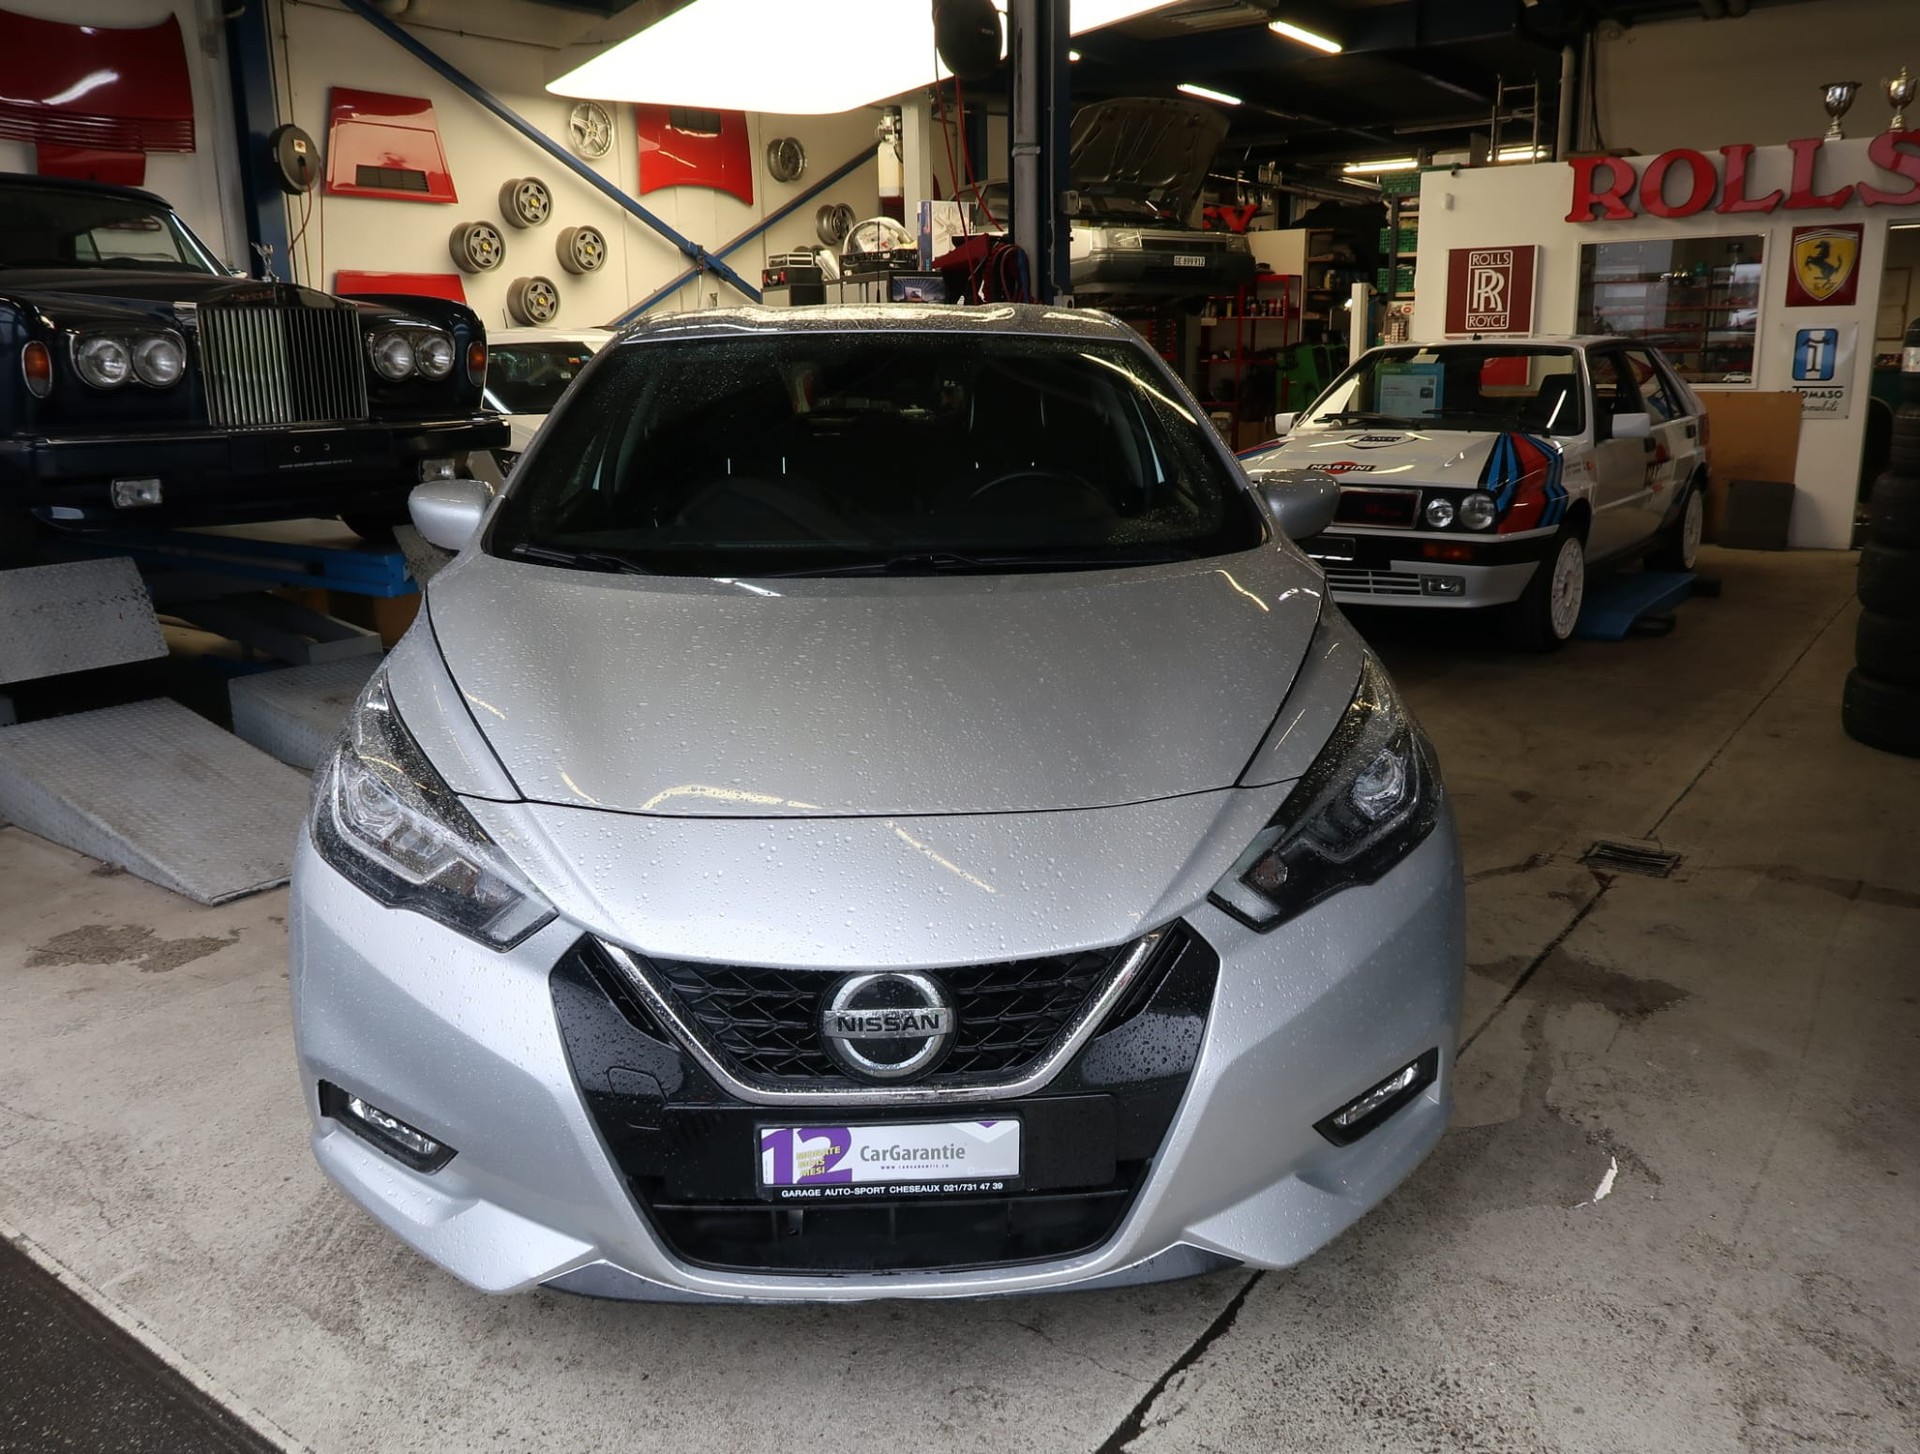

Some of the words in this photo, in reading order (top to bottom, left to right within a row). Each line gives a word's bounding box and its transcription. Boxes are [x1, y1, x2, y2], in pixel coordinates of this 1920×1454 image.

[1565, 129, 1920, 223] ROLLS
[1472, 253, 1510, 266] ROLLS
[1469, 316, 1506, 327] ROYCE
[837, 1014, 940, 1031] NISSAN
[761, 1127, 853, 1184] 12
[859, 1143, 965, 1162] CarGarantie
[800, 1167, 825, 1177] MESI
[781, 1189, 821, 1197] GARAGE
[824, 1186, 886, 1196] AUTO-SPORT
[889, 1184, 940, 1193] CHESEAUX
[943, 1183, 977, 1192] 021/731
[979, 1182, 991, 1190] 47
[992, 1182, 1004, 1190] 39
